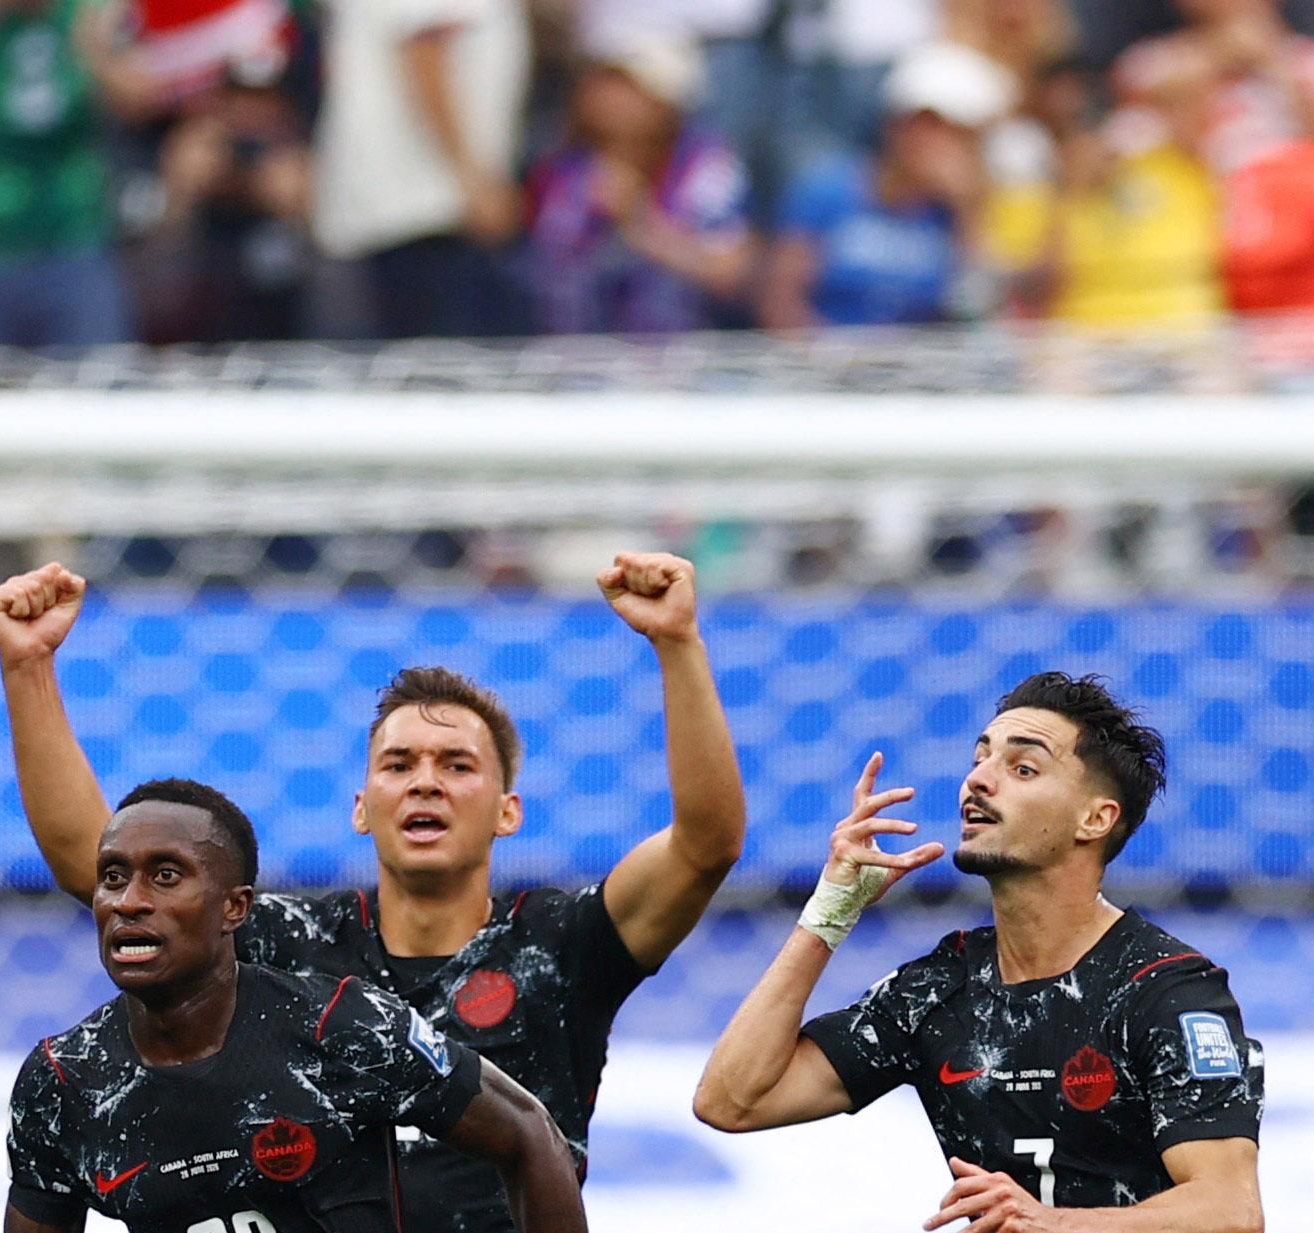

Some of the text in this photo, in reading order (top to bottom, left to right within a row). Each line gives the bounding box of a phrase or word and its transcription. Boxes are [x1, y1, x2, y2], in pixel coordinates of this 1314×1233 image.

[1064, 1072, 1112, 1087] CANADA
[192, 1152, 215, 1165] SOUTH
[215, 1148, 240, 1161] AFRICA
[255, 1142, 312, 1159] CANADA
[1013, 1137, 1055, 1208] 7
